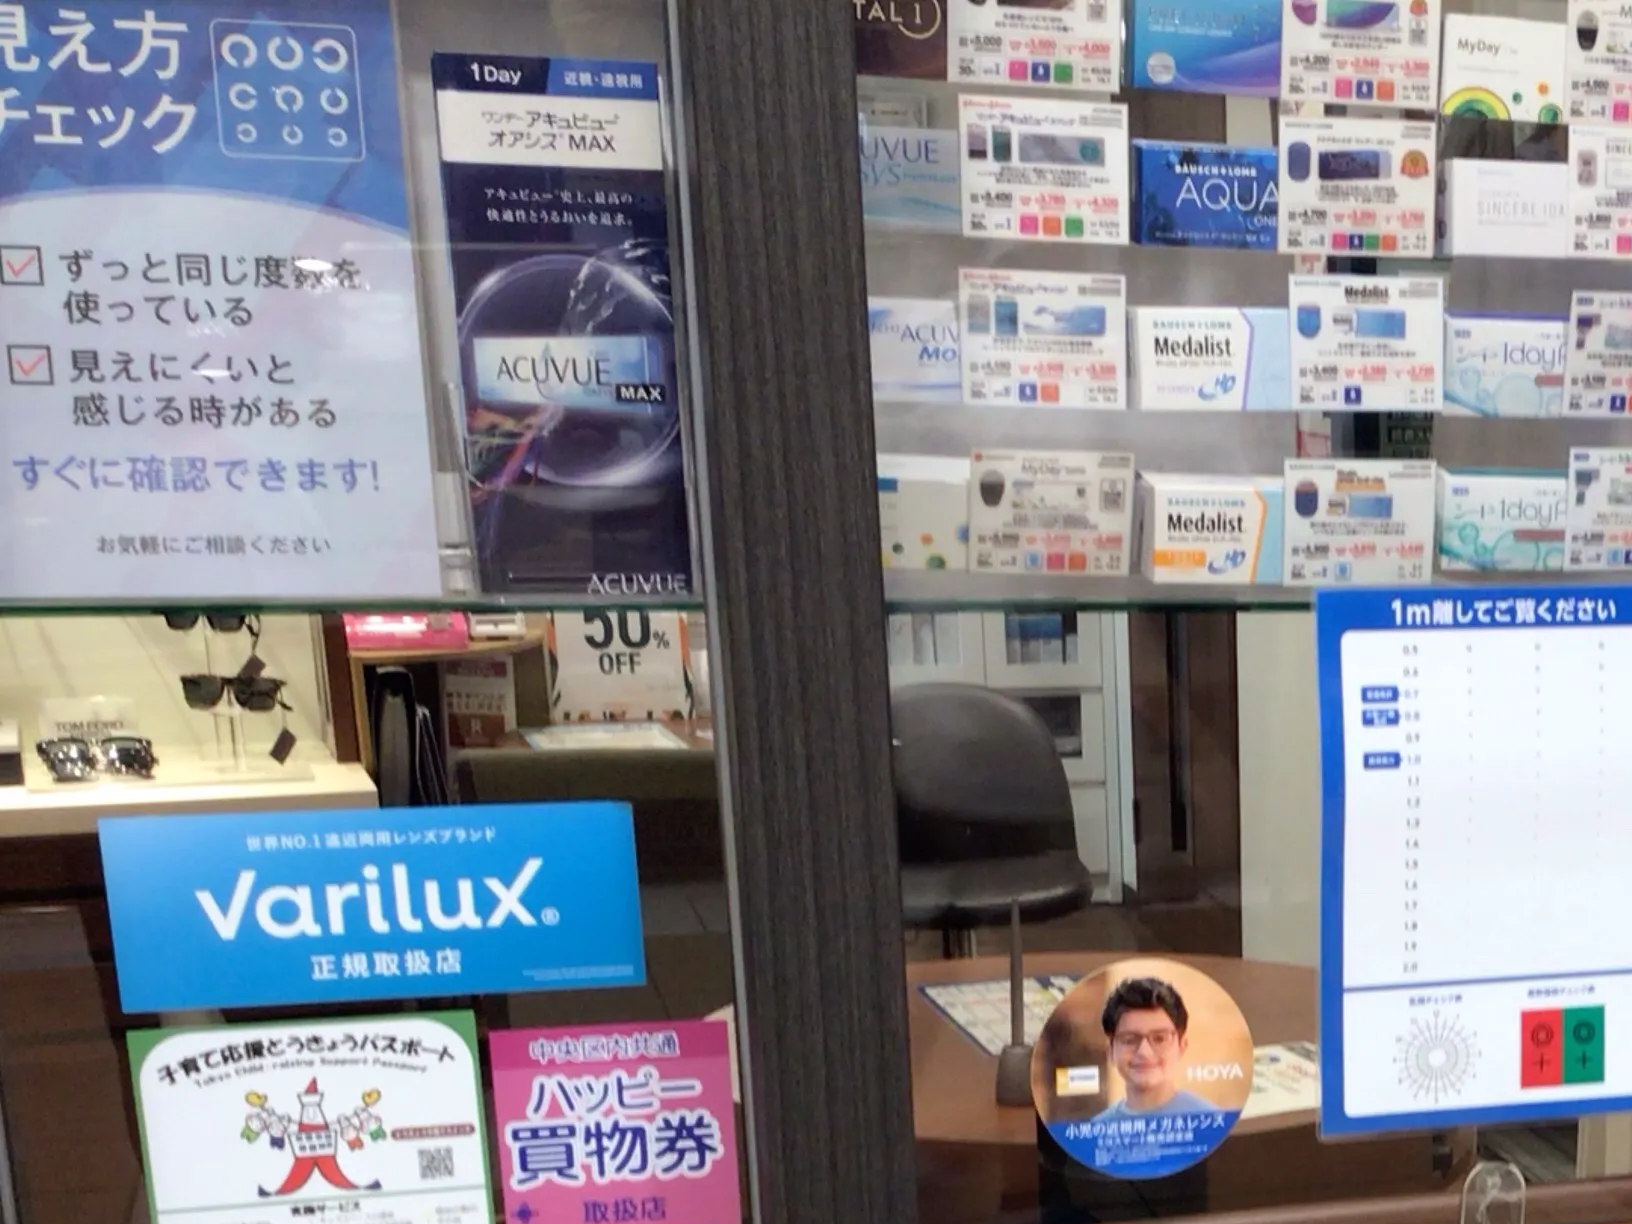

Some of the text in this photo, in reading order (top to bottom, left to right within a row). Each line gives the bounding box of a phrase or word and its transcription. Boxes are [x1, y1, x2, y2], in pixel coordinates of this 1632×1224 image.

[0, 5, 188, 79] 見え方
[1457, 38, 1501, 57] MyDay
[470, 63, 523, 86] 1Day
[0, 93, 197, 154] チェック
[569, 135, 616, 152] MAX
[63, 295, 254, 327] 使っている
[1154, 333, 1232, 358] Medalist
[70, 350, 295, 386] 見えにくいと
[497, 355, 612, 387] ACUVUE
[619, 385, 663, 401] MAX
[73, 394, 338, 430] 感じる時がある
[12, 454, 382, 494] すぐに確認できます!
[1167, 511, 1244, 534] Medalist
[97, 533, 332, 556] お気軽にご相談ください
[587, 573, 688, 595] ACUVUE
[1391, 597, 1617, 627] 1m離してご覧ください
[599, 652, 642, 675] OFF
[311, 947, 463, 982] 正規取扱店
[157, 1032, 456, 1086] 子育て応援とうきょうパスポート
[529, 1033, 681, 1061] 中央区内共通
[1185, 1063, 1244, 1082] HOYA
[530, 1069, 701, 1115] ハッピー
[509, 1111, 721, 1187] 買物券
[583, 1195, 668, 1223] 取扱店
